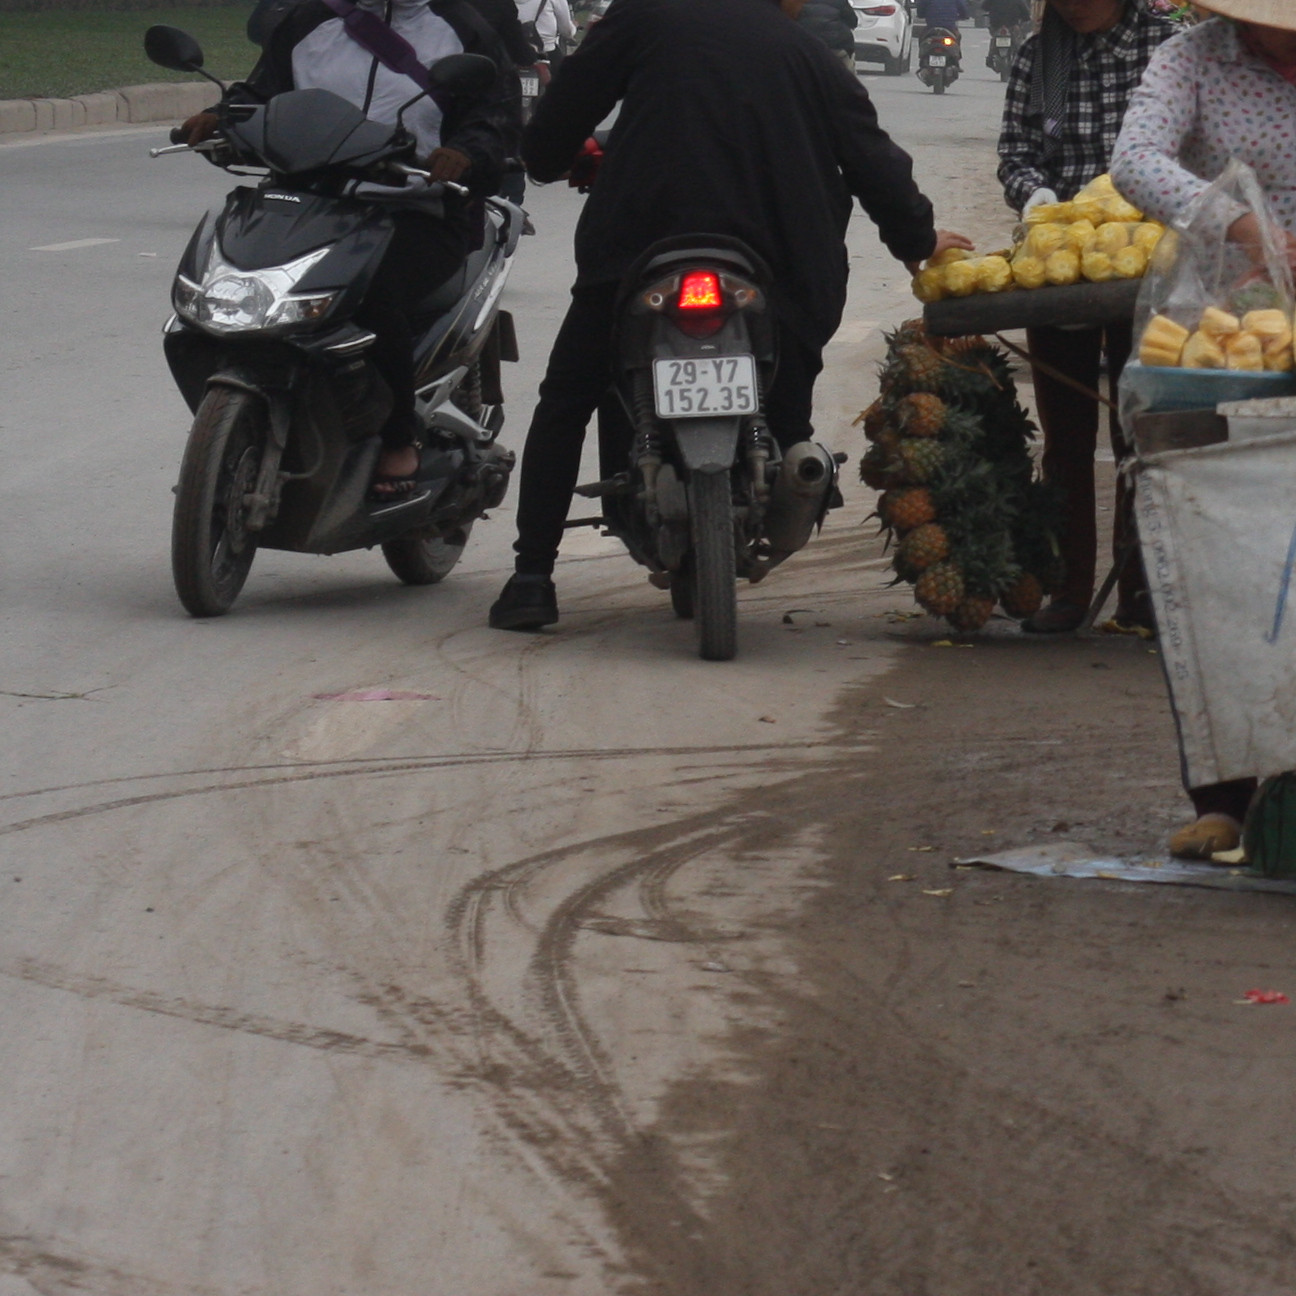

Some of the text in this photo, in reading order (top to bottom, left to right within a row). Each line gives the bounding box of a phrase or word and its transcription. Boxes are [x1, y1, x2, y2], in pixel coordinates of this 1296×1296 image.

[263, 193, 302, 203] HONDA
[668, 359, 739, 386] 29-Y7
[664, 386, 751, 413] 152.35
